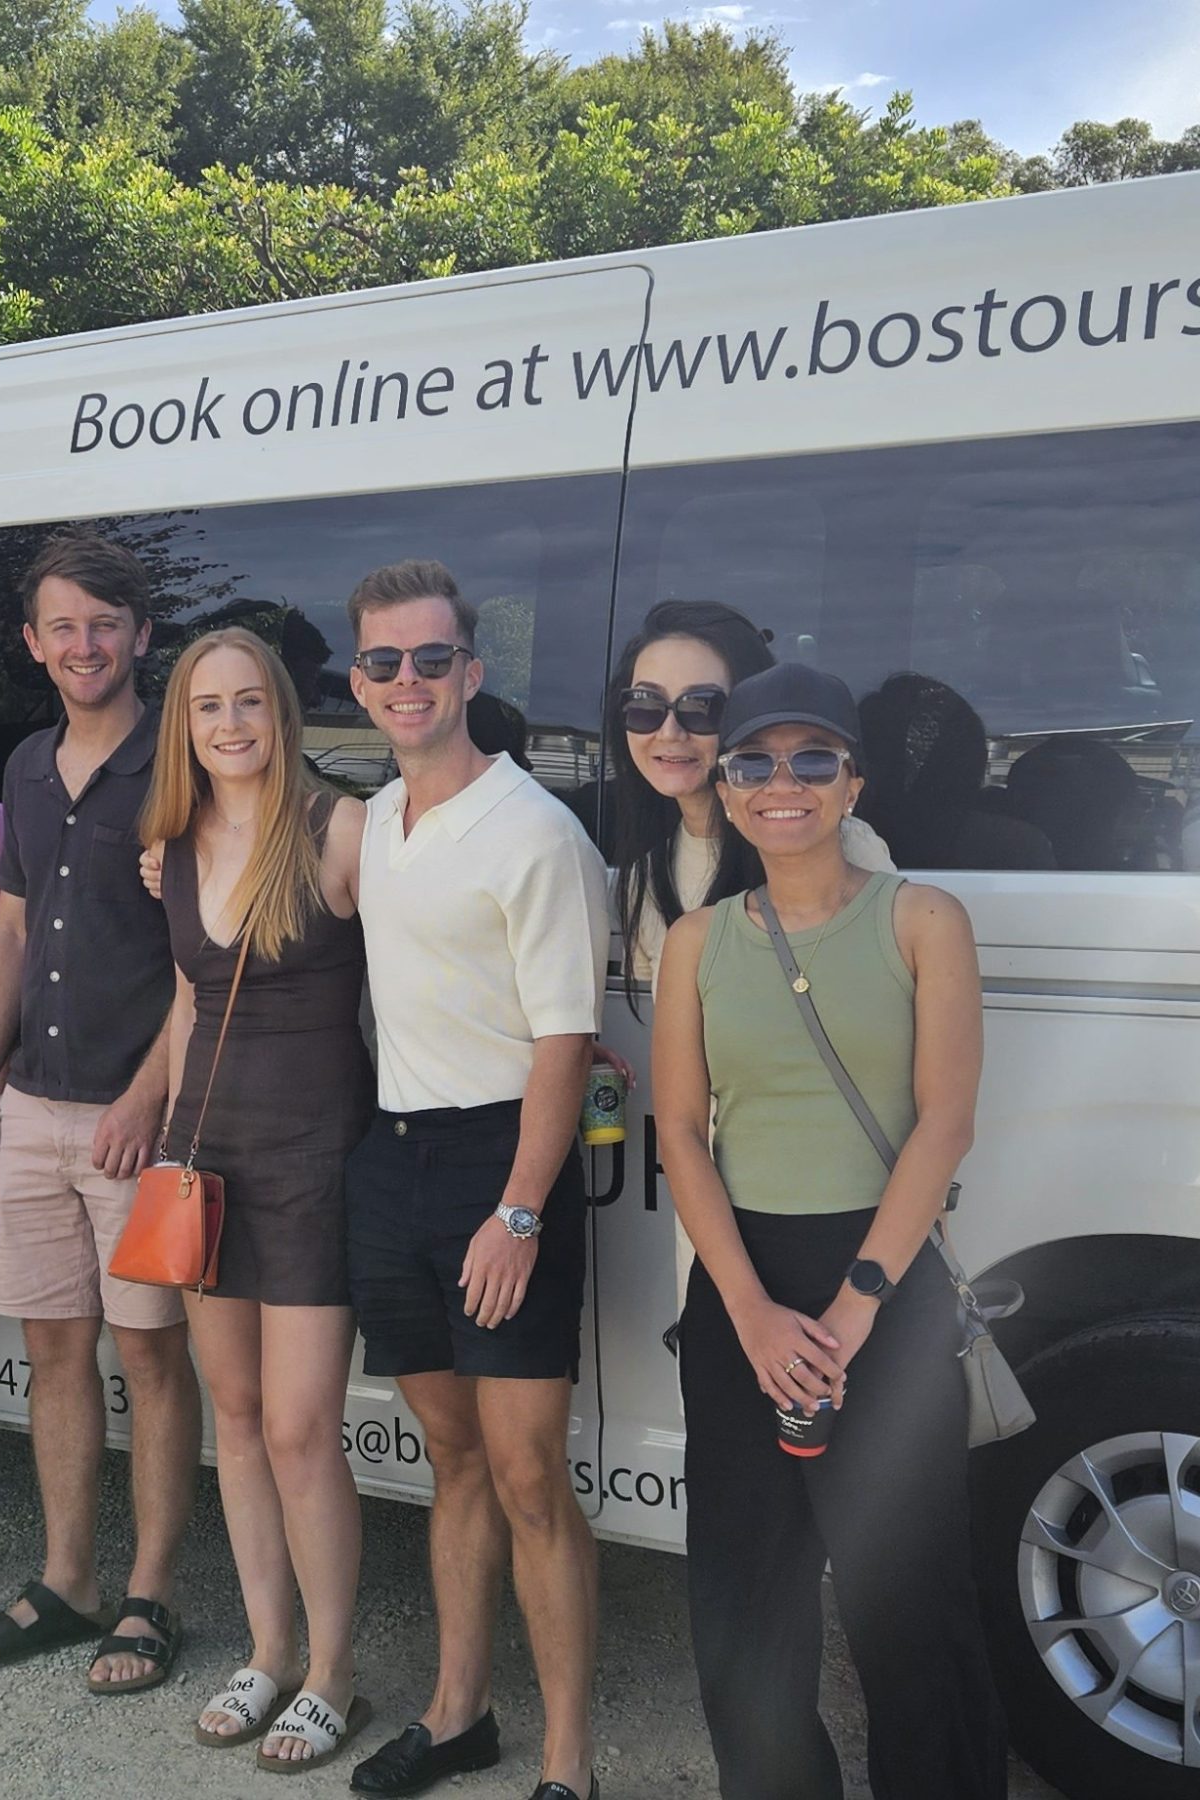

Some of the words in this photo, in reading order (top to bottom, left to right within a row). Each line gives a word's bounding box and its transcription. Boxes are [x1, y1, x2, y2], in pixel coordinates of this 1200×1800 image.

[70, 377, 226, 454] Book
[242, 360, 455, 436] online
[476, 344, 550, 410] at
